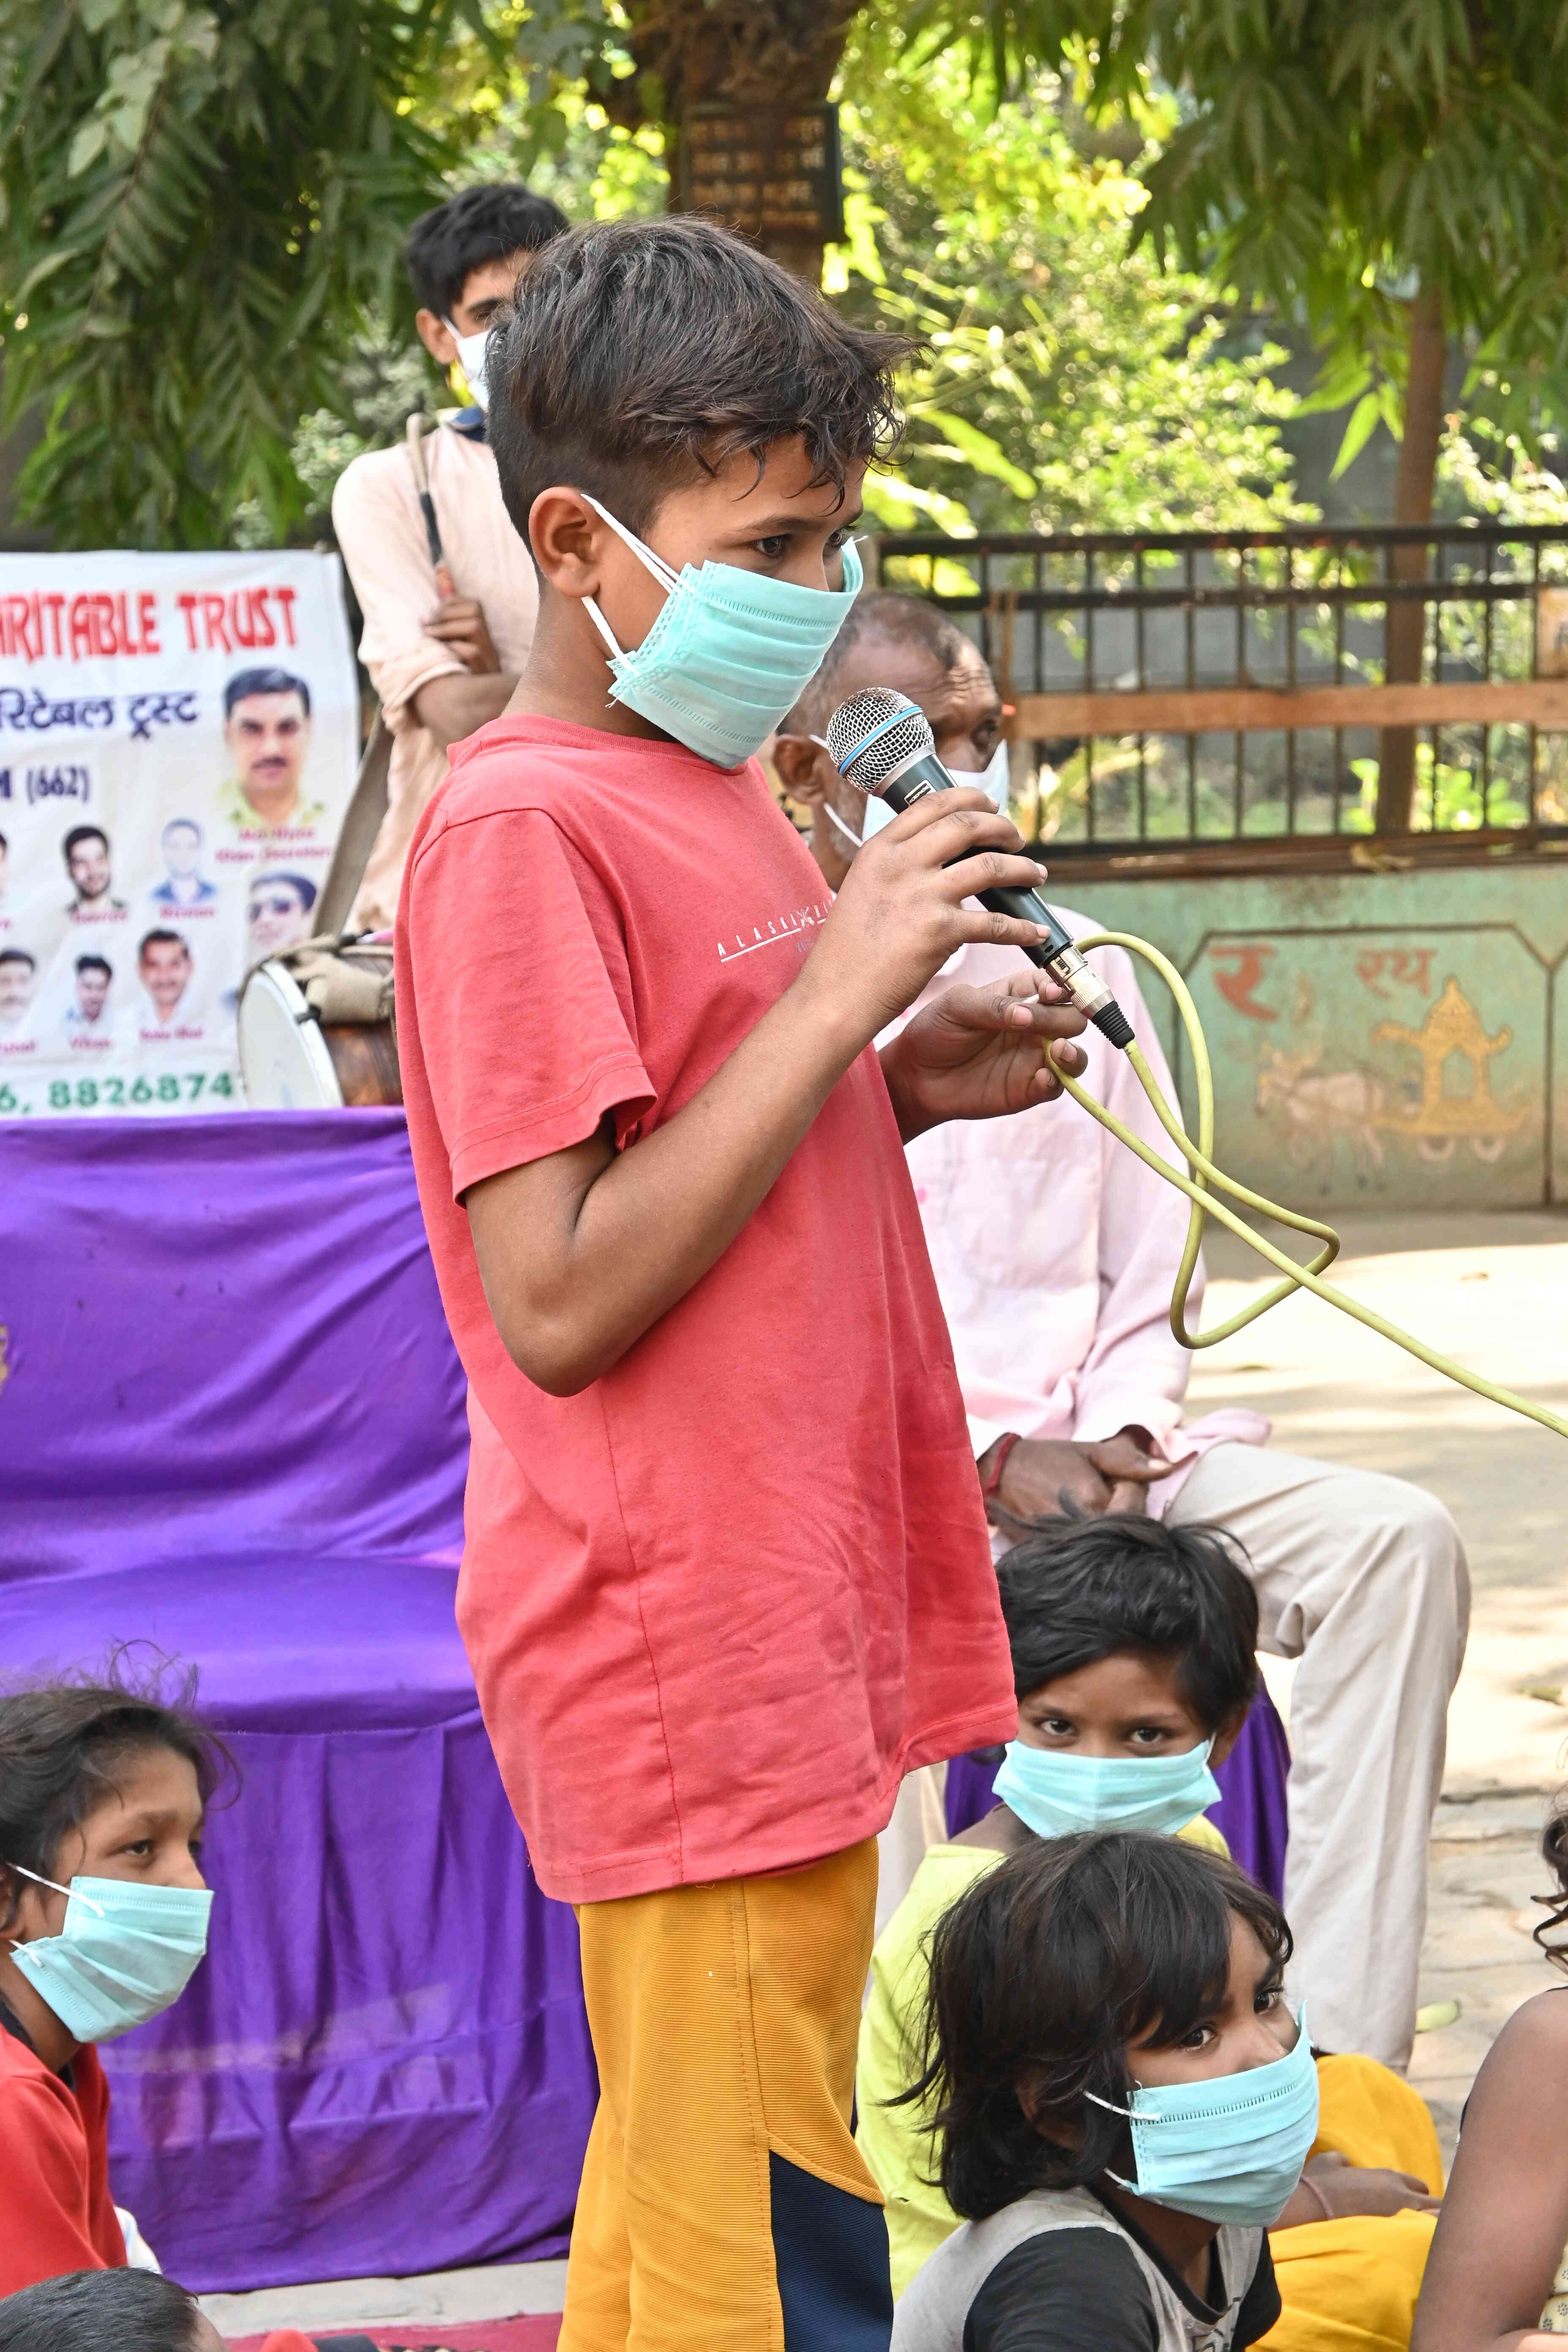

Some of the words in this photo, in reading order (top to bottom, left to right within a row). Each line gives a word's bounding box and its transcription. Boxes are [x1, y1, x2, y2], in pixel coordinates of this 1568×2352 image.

[0, 589, 161, 662] RITABLE
[176, 586, 297, 654] TRUST
[127, 691, 199, 741] ट्रस्ट
[27, 764, 90, 805] (662)
[1208, 945, 1278, 1021] र
